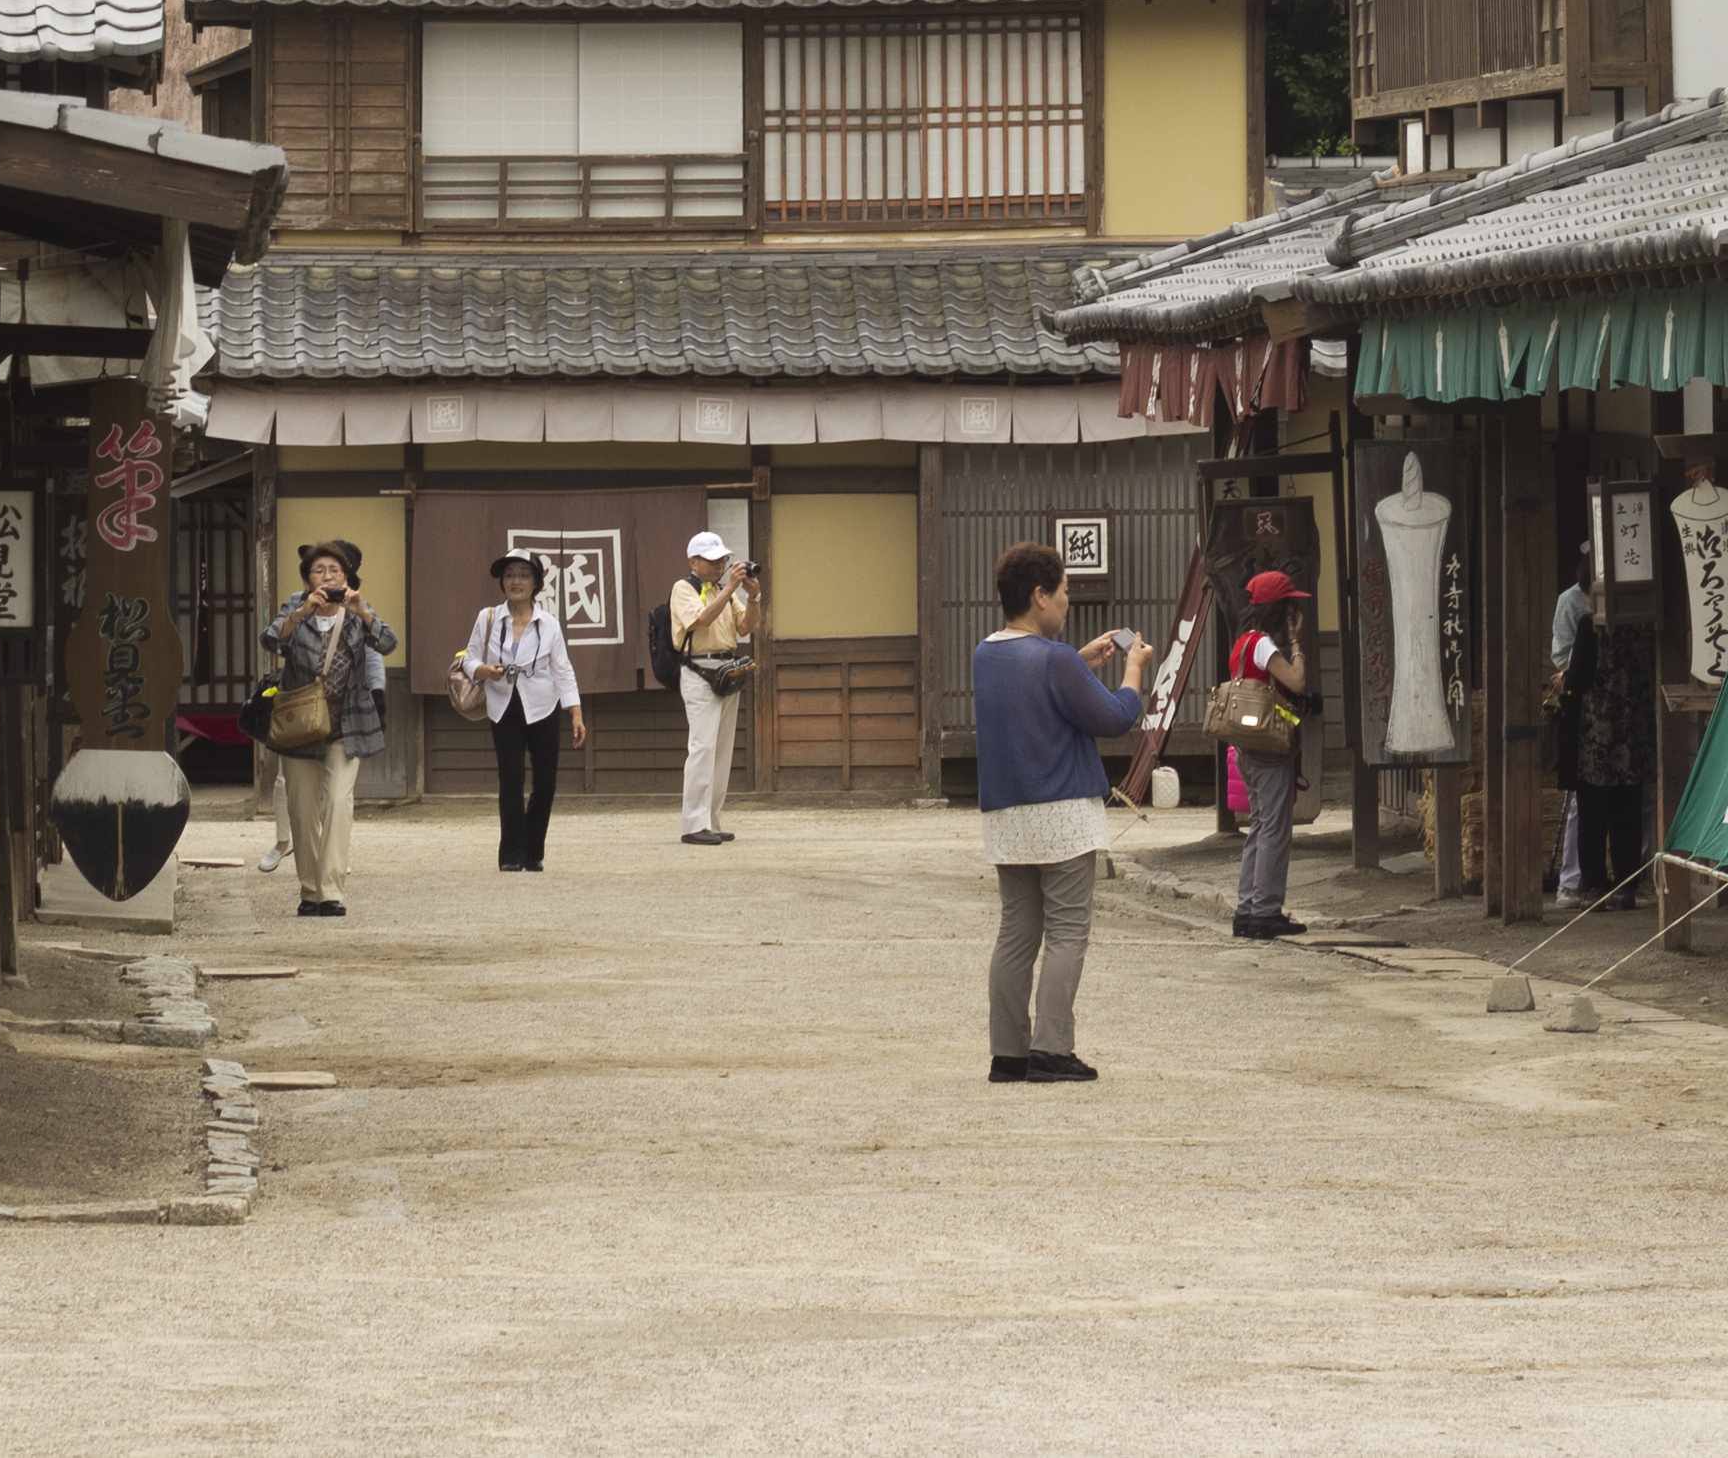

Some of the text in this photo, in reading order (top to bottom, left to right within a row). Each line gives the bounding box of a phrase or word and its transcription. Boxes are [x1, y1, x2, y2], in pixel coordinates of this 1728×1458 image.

[95, 419, 164, 552] 筆
[1067, 530, 1095, 563] 紙
[534, 554, 602, 624] 紙
